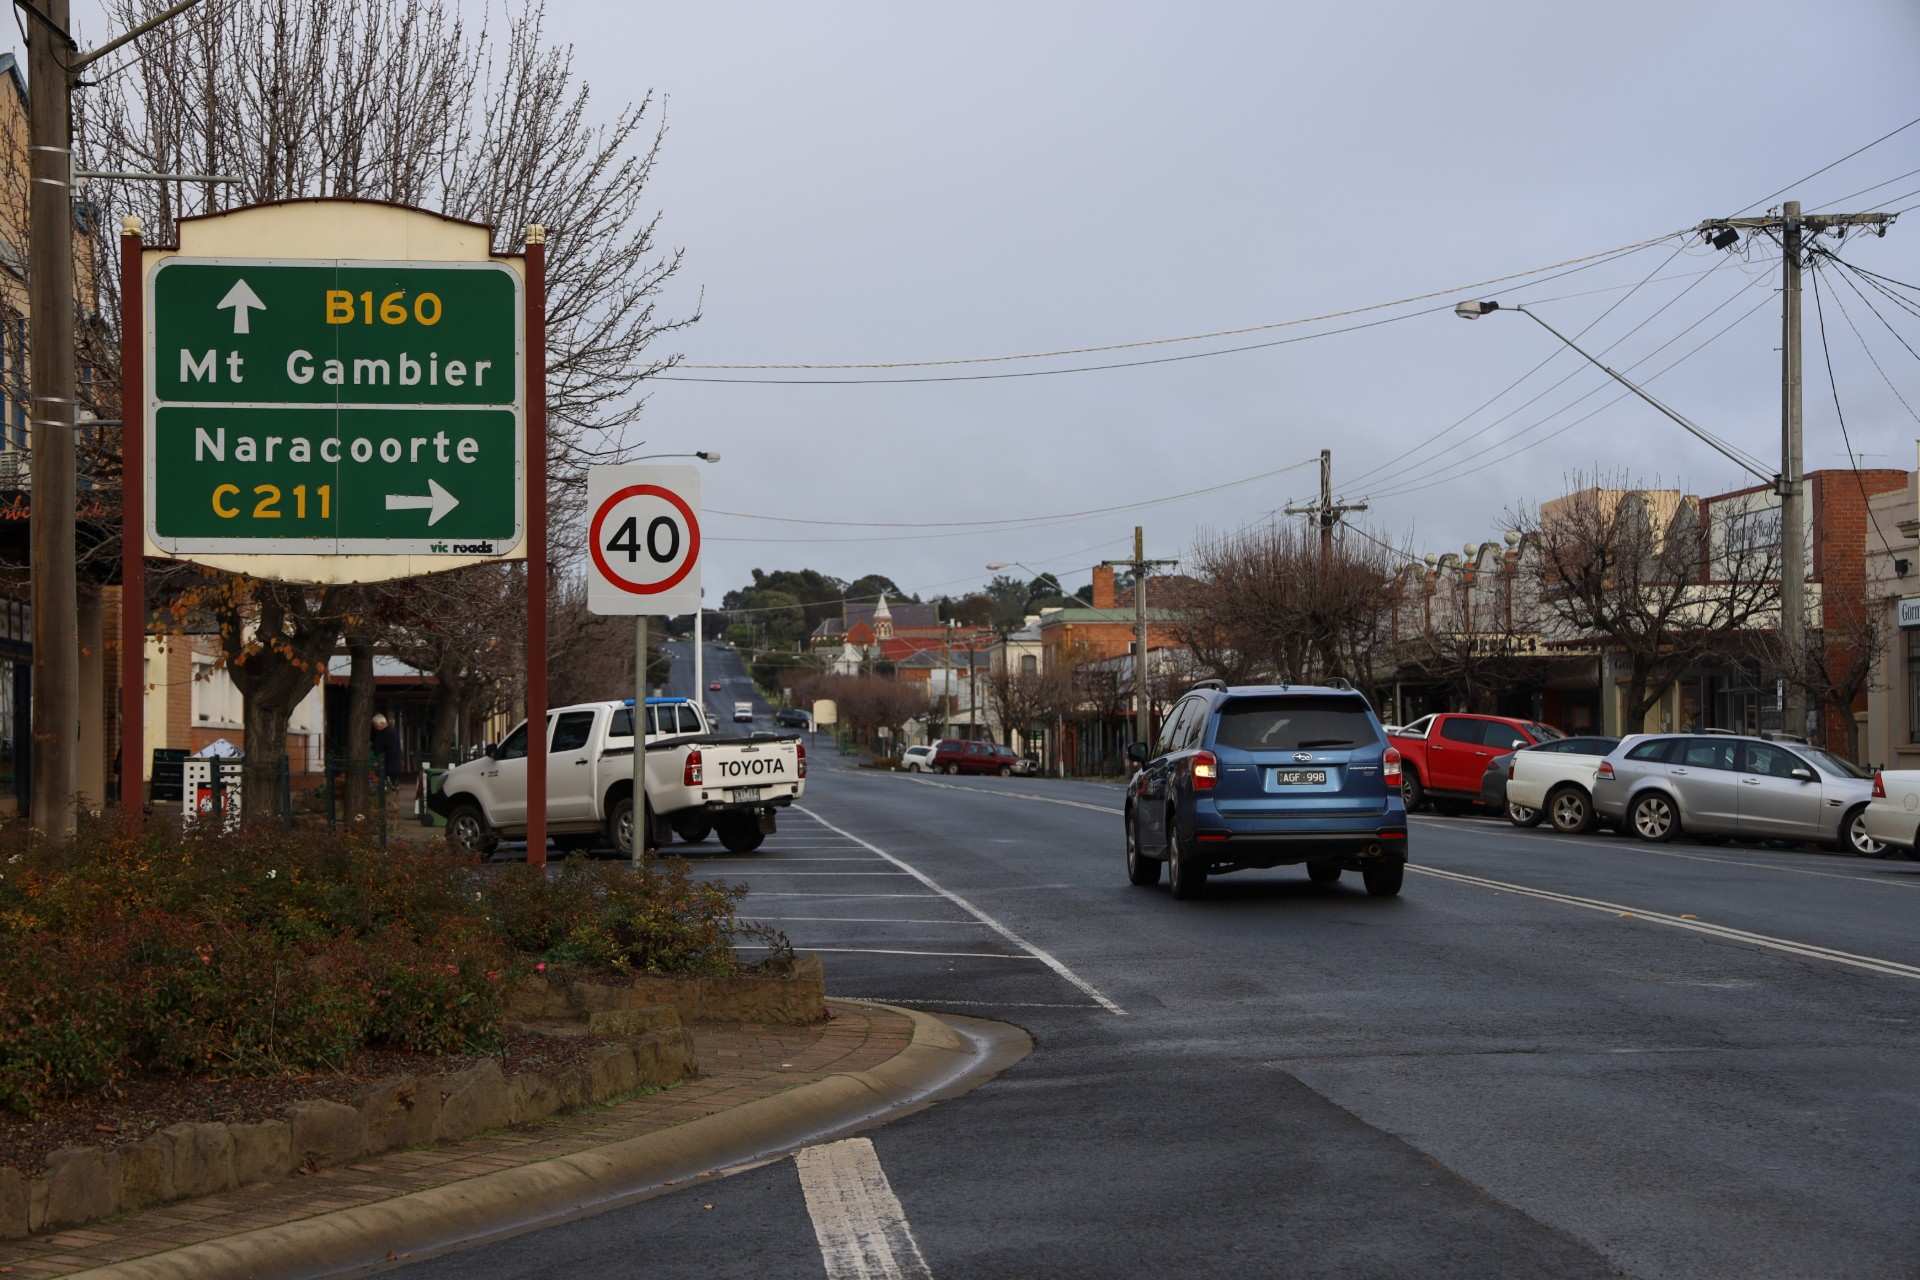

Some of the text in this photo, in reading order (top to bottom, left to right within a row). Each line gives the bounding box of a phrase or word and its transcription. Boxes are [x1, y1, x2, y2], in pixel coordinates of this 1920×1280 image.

[326, 290, 442, 326] B160
[180, 348, 492, 387] Mt Gambier
[195, 427, 480, 464] Naracoorte
[212, 483, 332, 519] C211
[430, 541, 493, 554] vic roads
[606, 516, 681, 564] 40
[719, 758, 785, 777] TOYOTA
